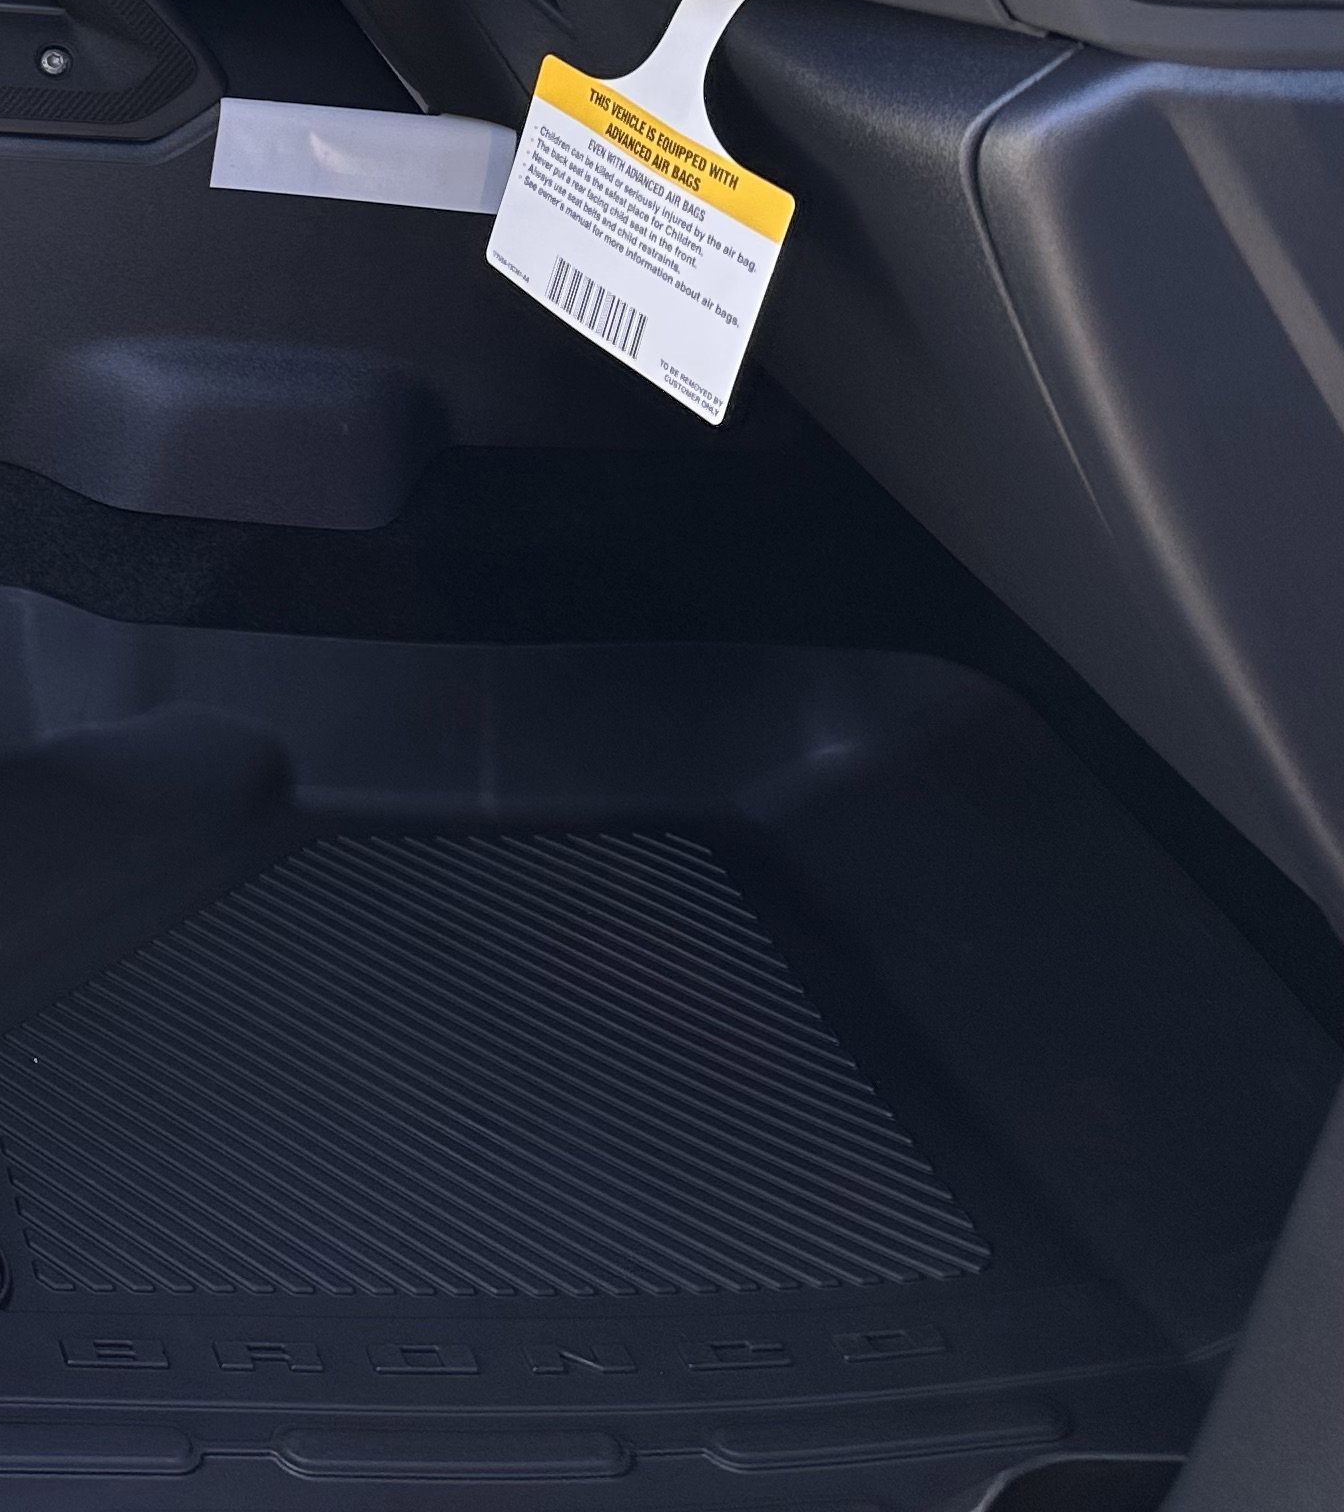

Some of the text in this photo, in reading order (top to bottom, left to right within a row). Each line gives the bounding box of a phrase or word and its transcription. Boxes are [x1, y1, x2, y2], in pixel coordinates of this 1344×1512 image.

[587, 138, 706, 223] EVEN WITH ADVANCED AIR BAGS
[589, 87, 740, 191] THIS VEHICLE IS EQUIPPED WITH
[604, 122, 702, 192] ADVANCED AIR BAGS
[531, 150, 554, 171] Never
[571, 179, 587, 194] rear
[629, 219, 648, 238] seat
[648, 230, 658, 244] in
[658, 236, 673, 253] the
[536, 137, 551, 155] The
[550, 147, 569, 168] back
[583, 170, 592, 183] is
[591, 176, 604, 192] the
[626, 202, 650, 223] place
[650, 215, 665, 231] for
[664, 224, 704, 257] Children.
[570, 147, 585, 162] can
[584, 154, 595, 170] be
[614, 178, 624, 189] or
[661, 206, 694, 234] injured
[693, 225, 706, 243] by
[706, 234, 722, 251] the
[722, 245, 737, 259] air
[736, 252, 756, 273] bag.
[523, 175, 538, 192] See
[591, 223, 604, 239] for
[624, 246, 674, 285] information
[674, 280, 701, 303] about
[700, 297, 715, 311] air
[714, 303, 740, 328] bags.
[58, 1324, 950, 1376] BRONCO
